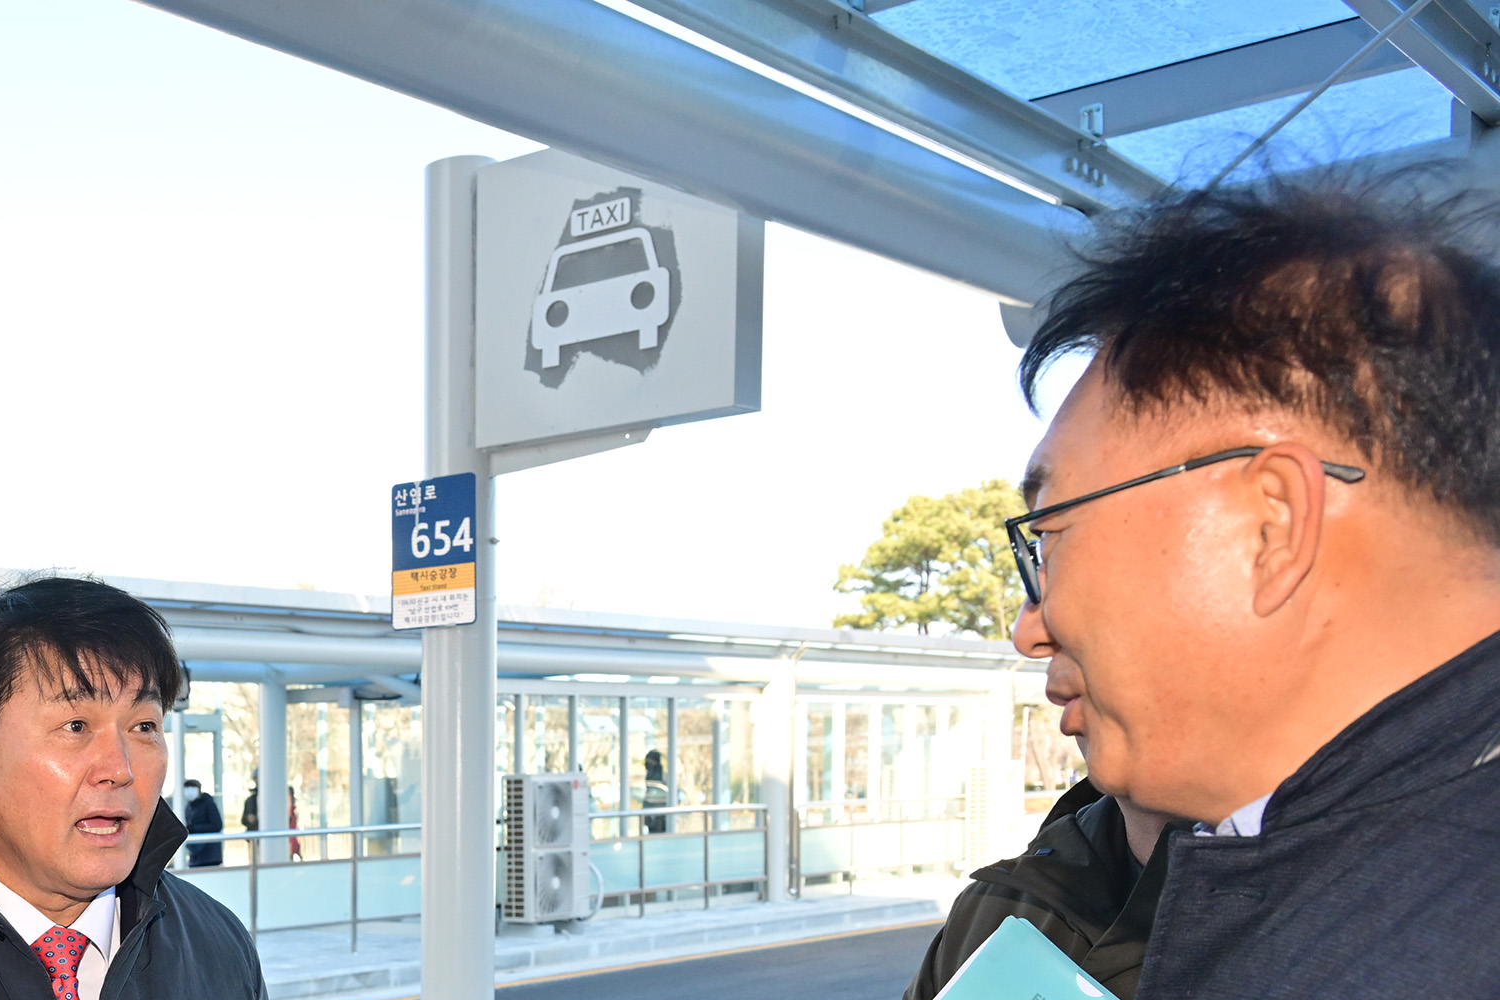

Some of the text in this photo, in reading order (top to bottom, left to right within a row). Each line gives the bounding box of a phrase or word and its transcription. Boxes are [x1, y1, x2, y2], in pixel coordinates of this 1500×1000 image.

[577, 202, 624, 231] TAXI
[395, 485, 437, 507] 산업로
[411, 517, 473, 558] 654
[411, 568, 457, 581] 택시승강장
